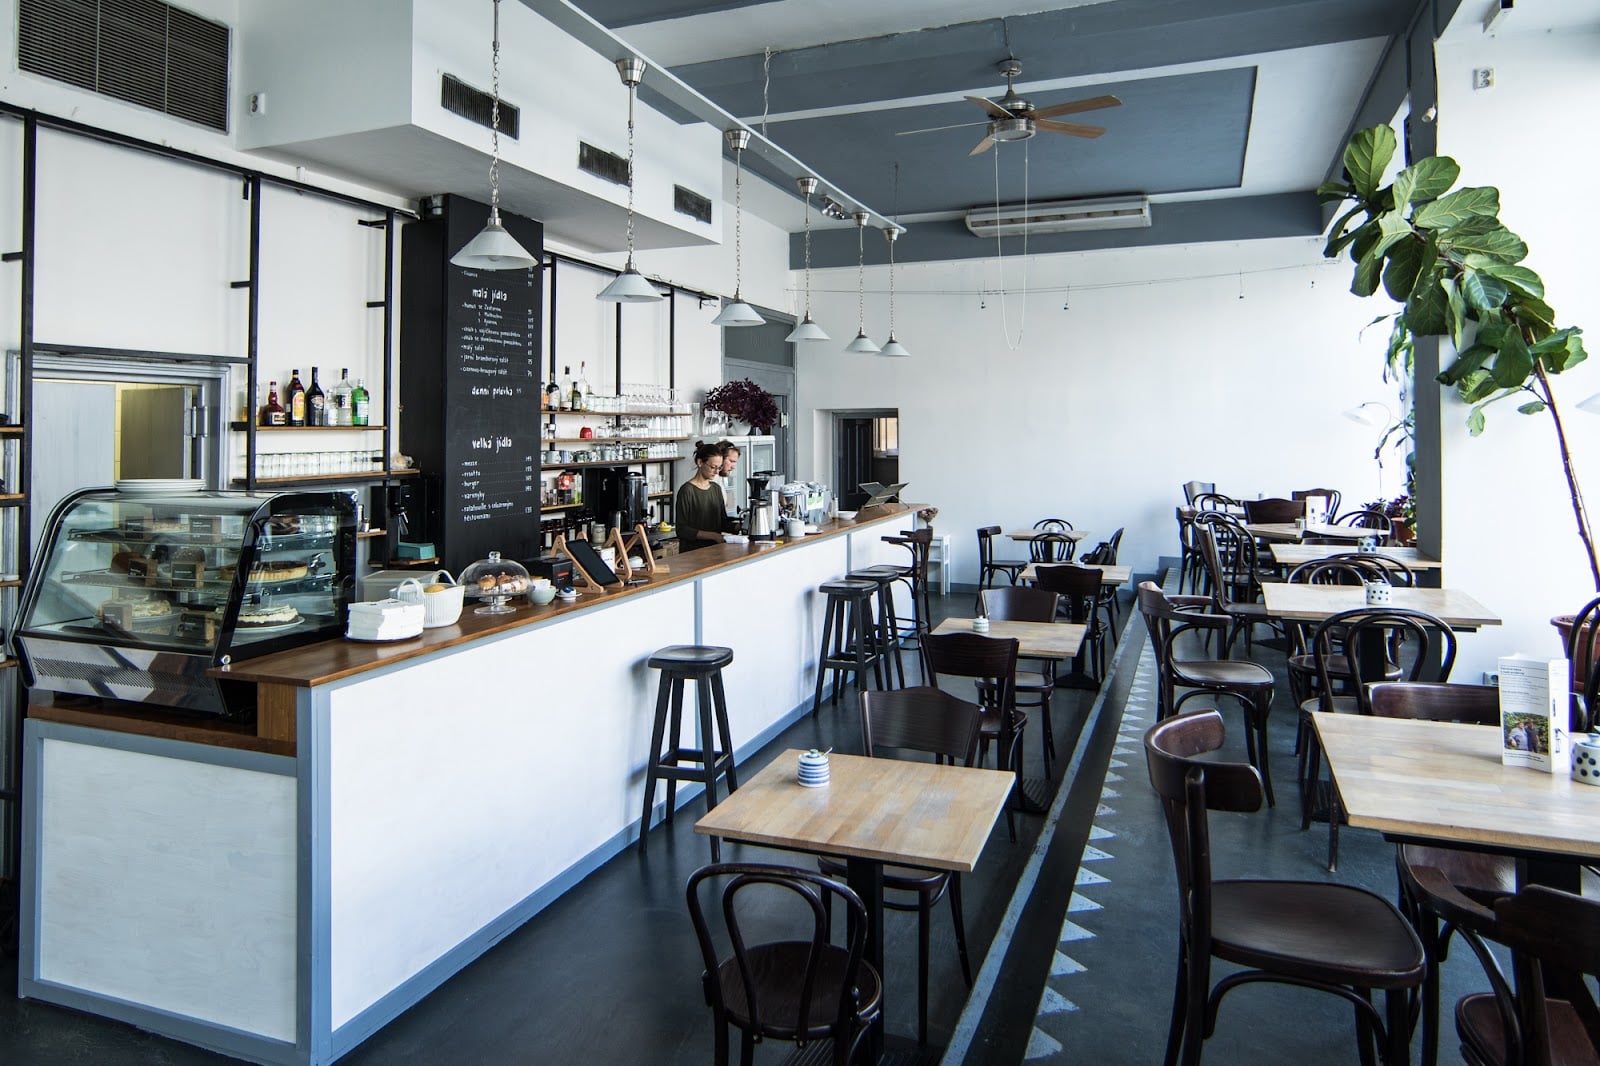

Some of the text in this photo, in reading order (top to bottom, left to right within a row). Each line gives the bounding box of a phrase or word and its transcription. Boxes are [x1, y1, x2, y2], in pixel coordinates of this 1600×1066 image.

[472, 288, 508, 304] malá jídla
[472, 385, 490, 396] denní
[492, 386, 512, 400] polévka
[472, 436, 512, 454] velká jídla
